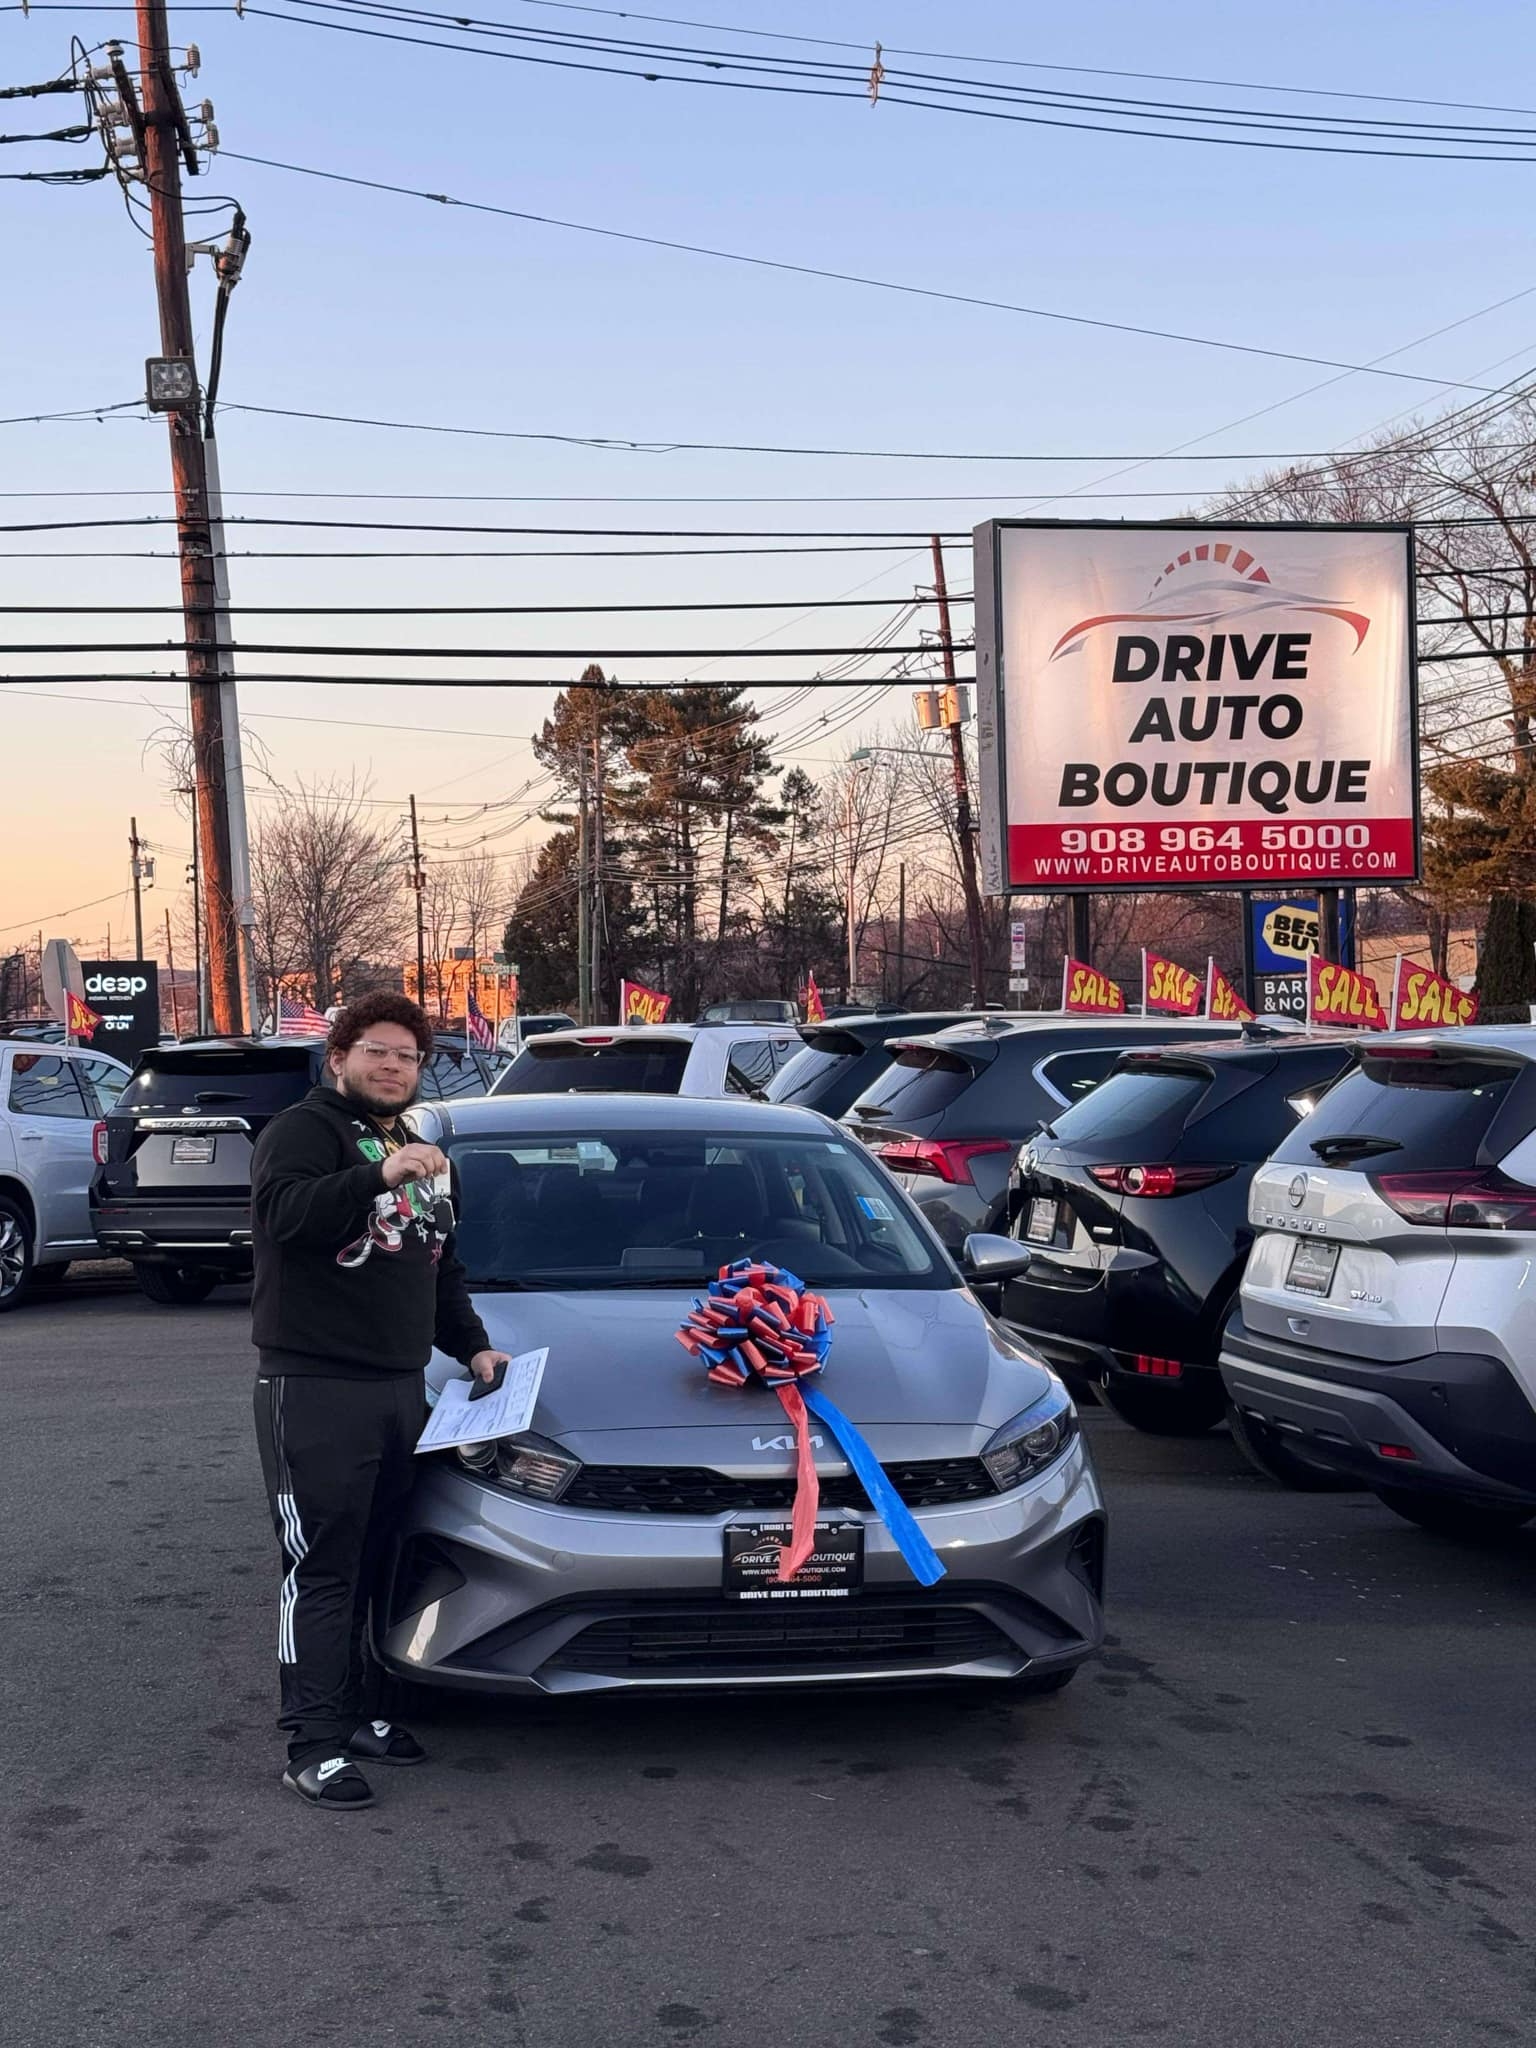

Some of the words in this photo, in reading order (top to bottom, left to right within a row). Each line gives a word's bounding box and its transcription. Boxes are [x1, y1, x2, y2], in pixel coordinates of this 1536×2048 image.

[1112, 633, 1312, 683] DRIVE
[1129, 694, 1303, 744] AUTO
[1058, 760, 1370, 814] BOUTIQUE
[1061, 828, 1146, 854] 908
[1160, 826, 1244, 852] 964
[1261, 824, 1370, 850] 5000
[1034, 851, 1397, 876] WWW.DRIVEAUTOBOUTIQUE.COM
[1273, 914, 1319, 938] BES
[85, 973, 147, 996] deep
[1070, 970, 1120, 1008] SALE
[1150, 962, 1200, 1006] SALE
[1264, 981, 1307, 994] BAR
[1265, 1215, 1327, 1233] ROGUE
[741, 1555, 772, 1564] DRIVE
[320, 1757, 344, 1773] NIKE
